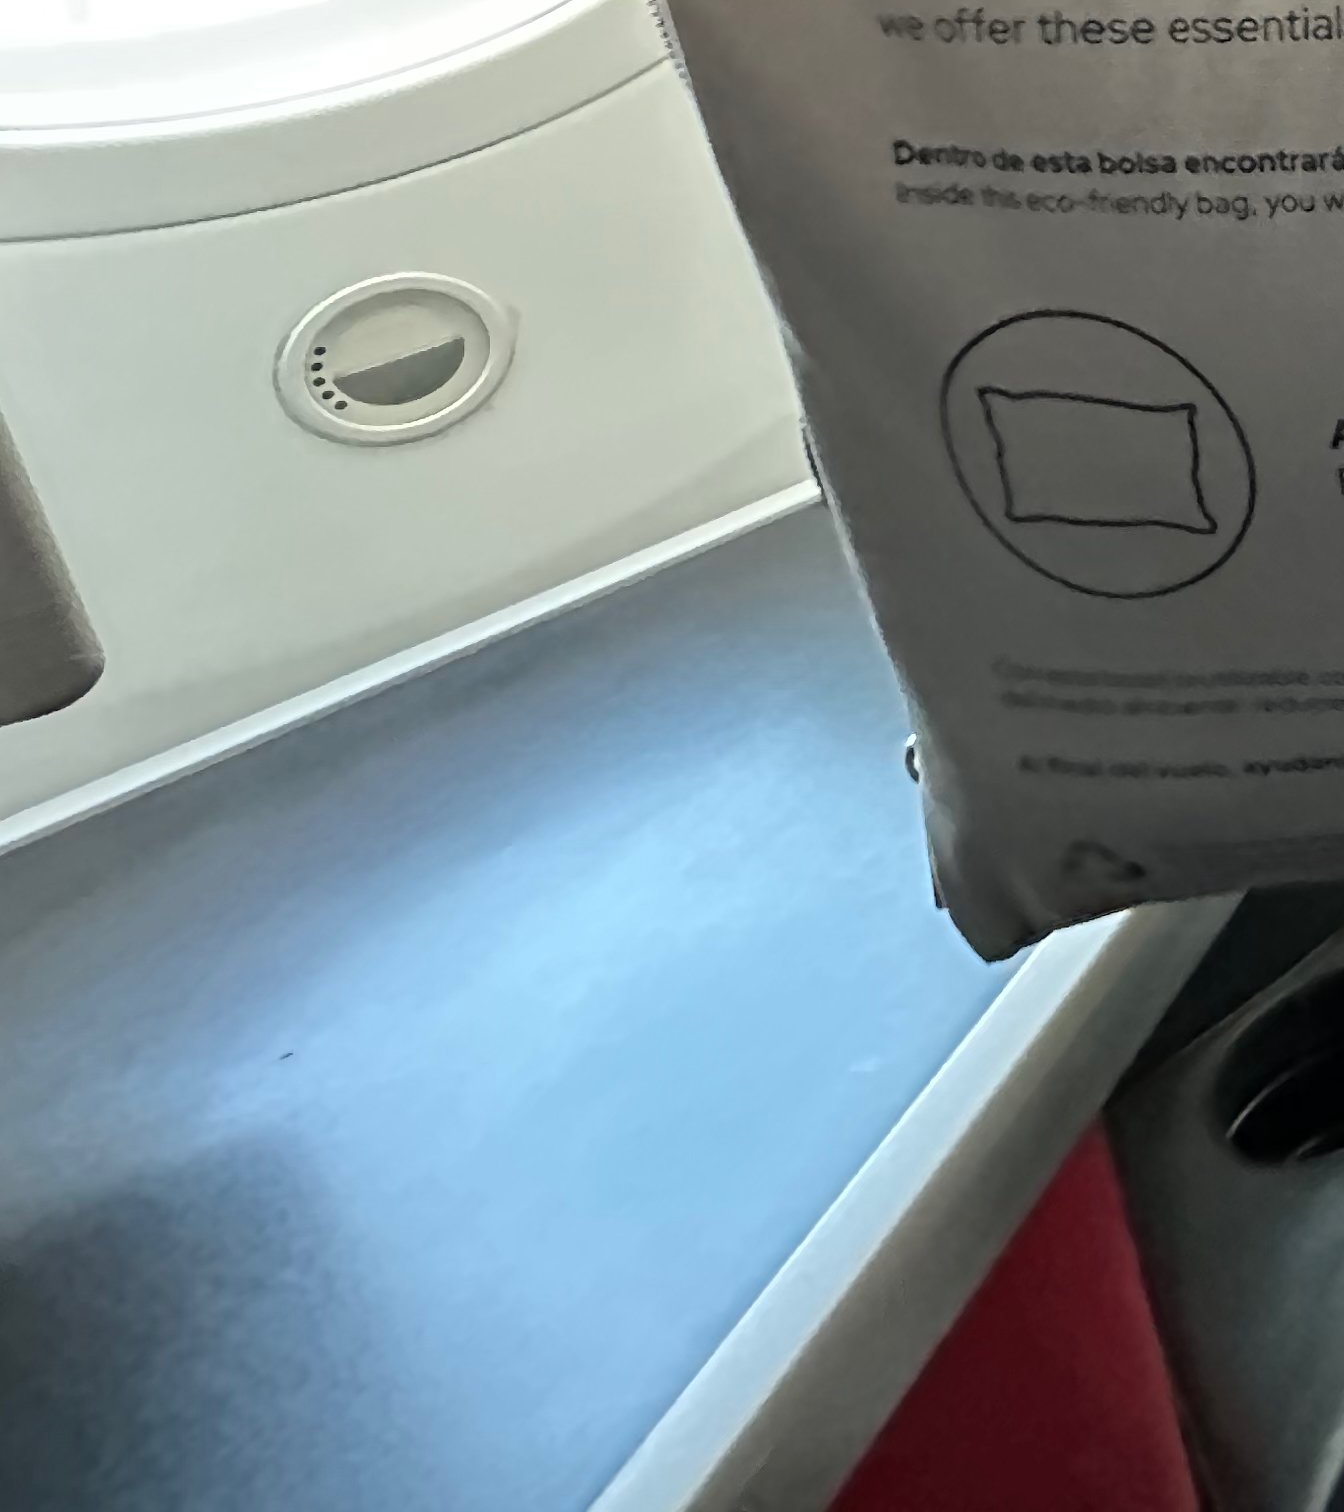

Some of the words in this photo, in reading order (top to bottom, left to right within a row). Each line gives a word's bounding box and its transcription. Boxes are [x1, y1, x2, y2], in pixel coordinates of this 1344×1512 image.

[878, 10, 925, 44] we
[934, 4, 1026, 46] offer
[1036, 4, 1156, 46] these
[893, 139, 986, 169] Dentro
[992, 149, 1025, 173] de
[1032, 151, 1093, 175] esta
[1097, 150, 1178, 176] bolsa
[896, 182, 975, 207] Inside
[1026, 190, 1186, 221] eco-friendly
[1196, 190, 1257, 220] bag,
[1264, 192, 1315, 218] you
